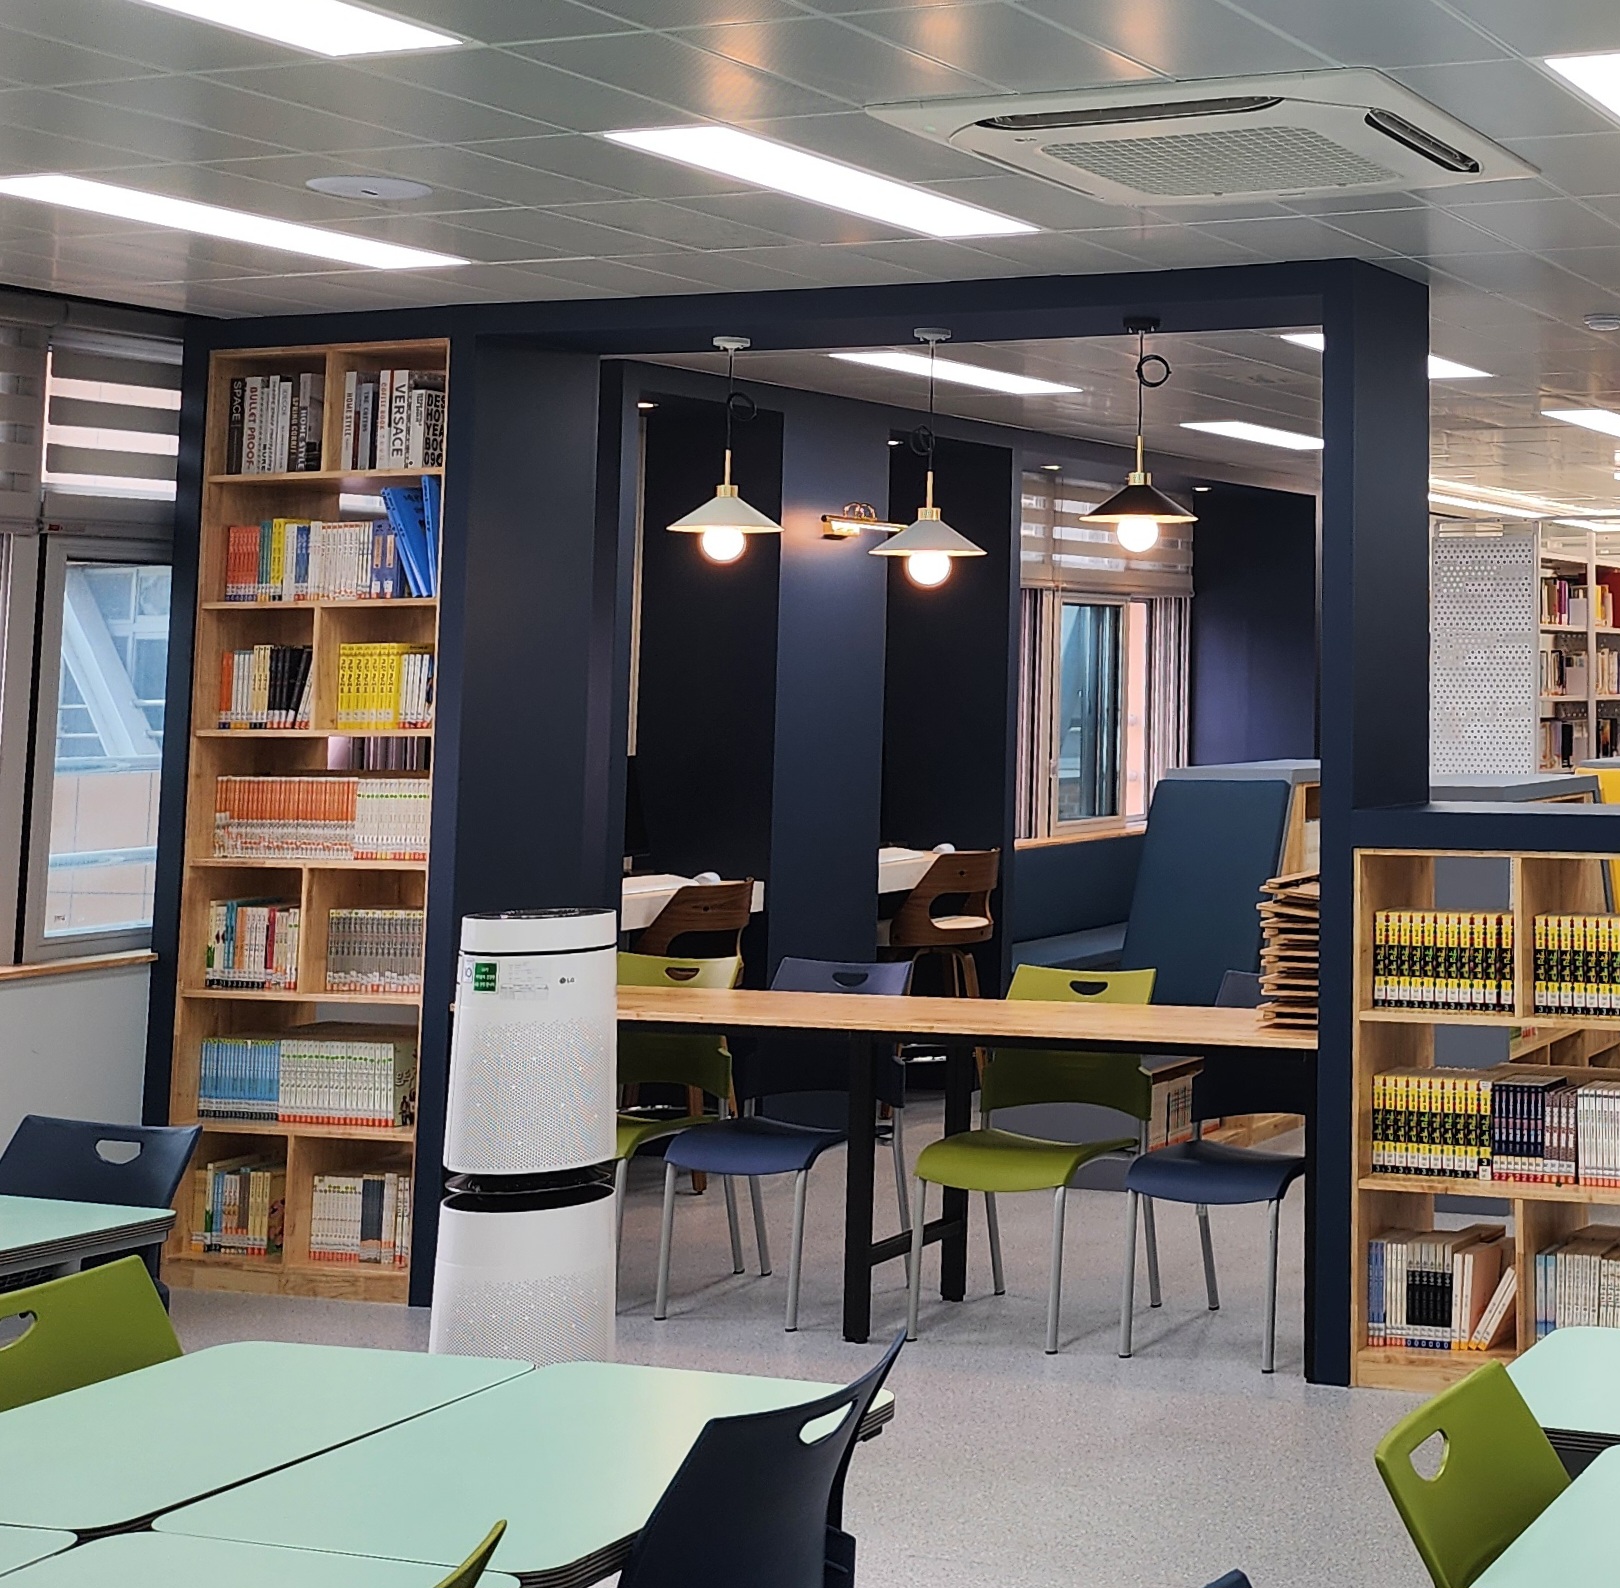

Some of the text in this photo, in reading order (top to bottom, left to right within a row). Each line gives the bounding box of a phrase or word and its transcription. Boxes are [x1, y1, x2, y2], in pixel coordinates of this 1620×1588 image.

[231, 381, 242, 422] SPACE
[345, 392, 353, 414] HOME
[299, 409, 308, 438] HOME
[391, 383, 406, 457] VERSACE
